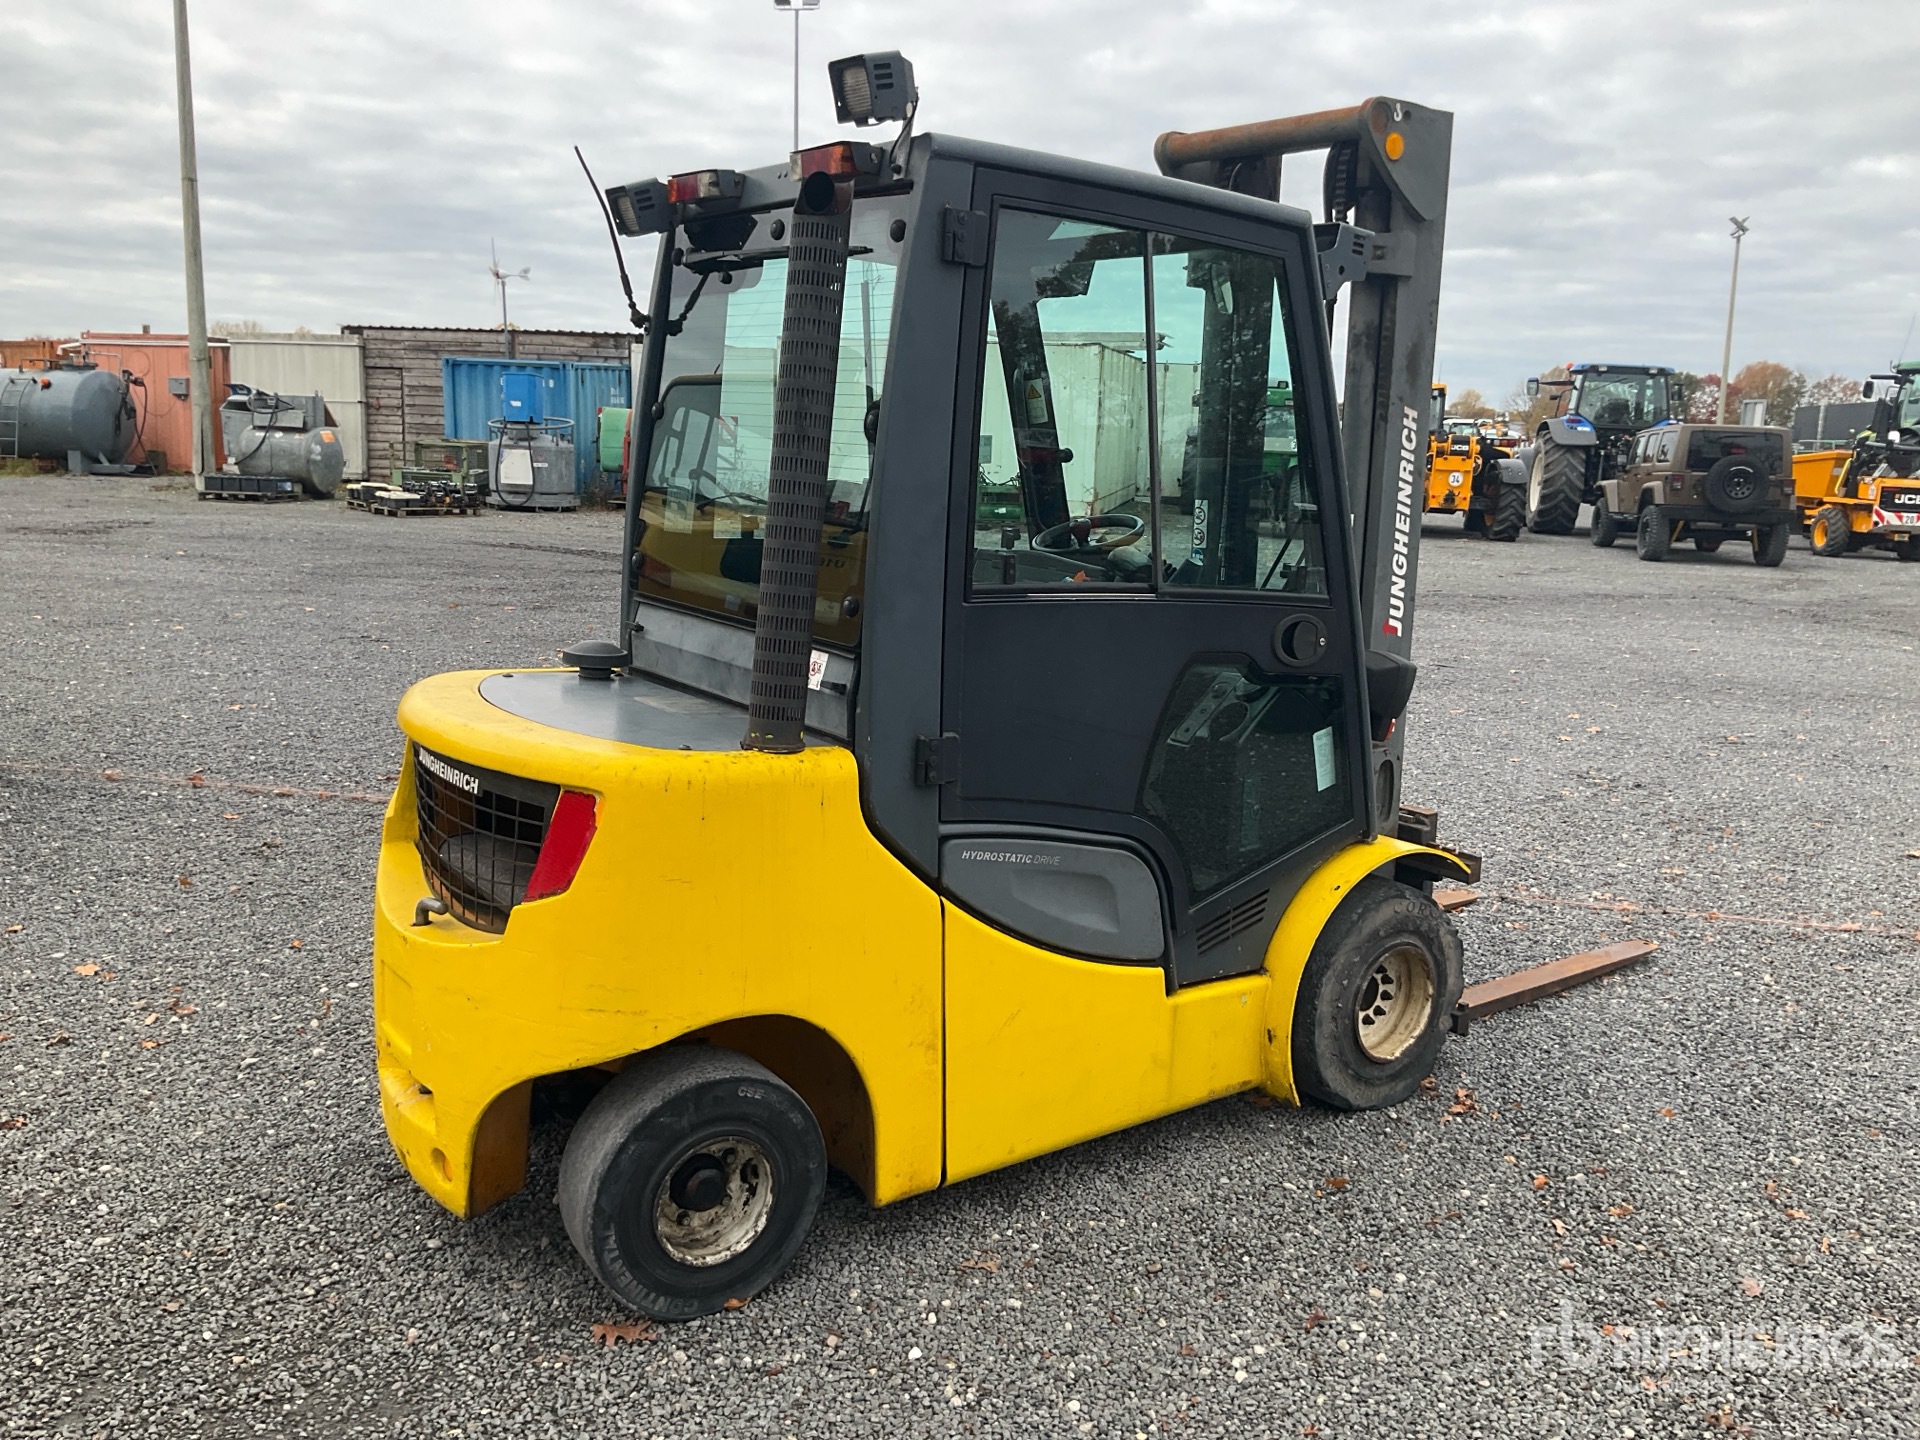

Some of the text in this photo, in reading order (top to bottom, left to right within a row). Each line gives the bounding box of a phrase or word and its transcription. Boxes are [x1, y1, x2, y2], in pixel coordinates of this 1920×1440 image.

[1451, 474, 1460, 484] 34
[1386, 405, 1418, 638] JUNGHEINRICH
[1904, 515, 1915, 525] 20
[418, 746, 479, 795] JUNGHEINRICH
[961, 850, 1061, 866] HYDROSTATIC DRIVE
[600, 1222, 699, 1314] CONTINENTAL
